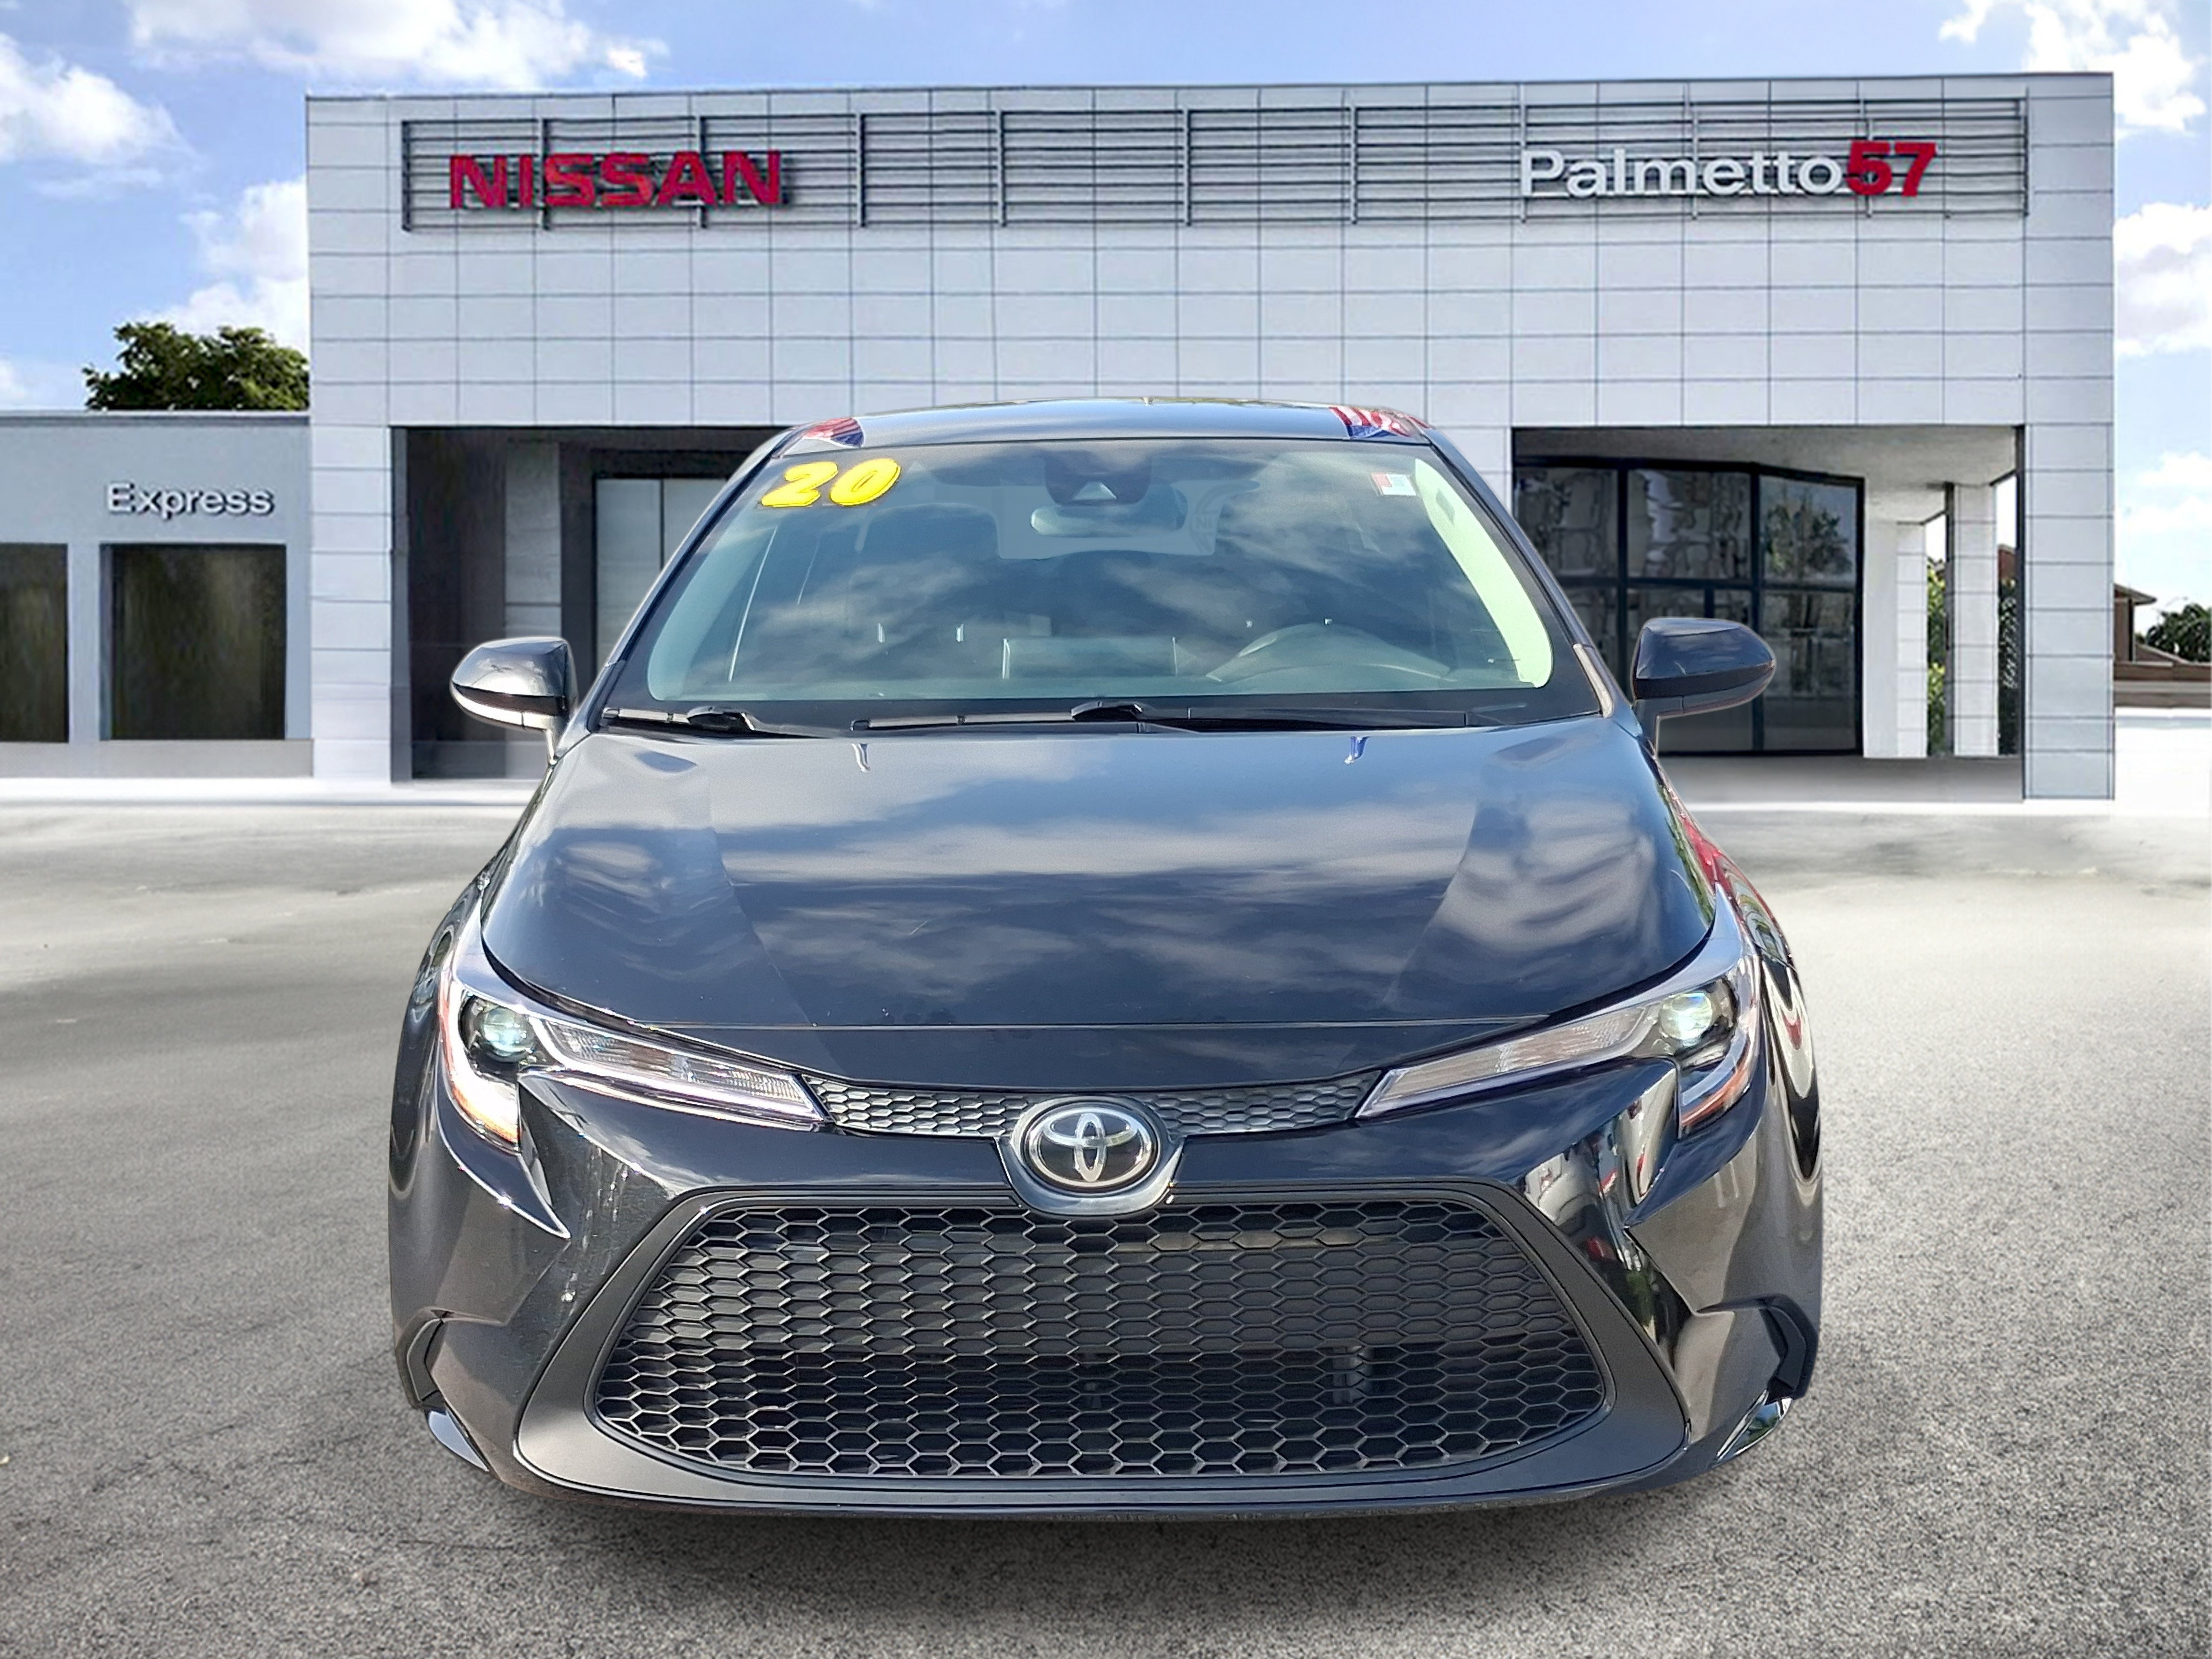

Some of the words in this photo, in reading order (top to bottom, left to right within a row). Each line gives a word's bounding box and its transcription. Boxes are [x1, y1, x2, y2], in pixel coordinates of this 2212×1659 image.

[450, 151, 782, 209] NISSAN
[107, 483, 275, 520] Express
[761, 458, 901, 507] 20
